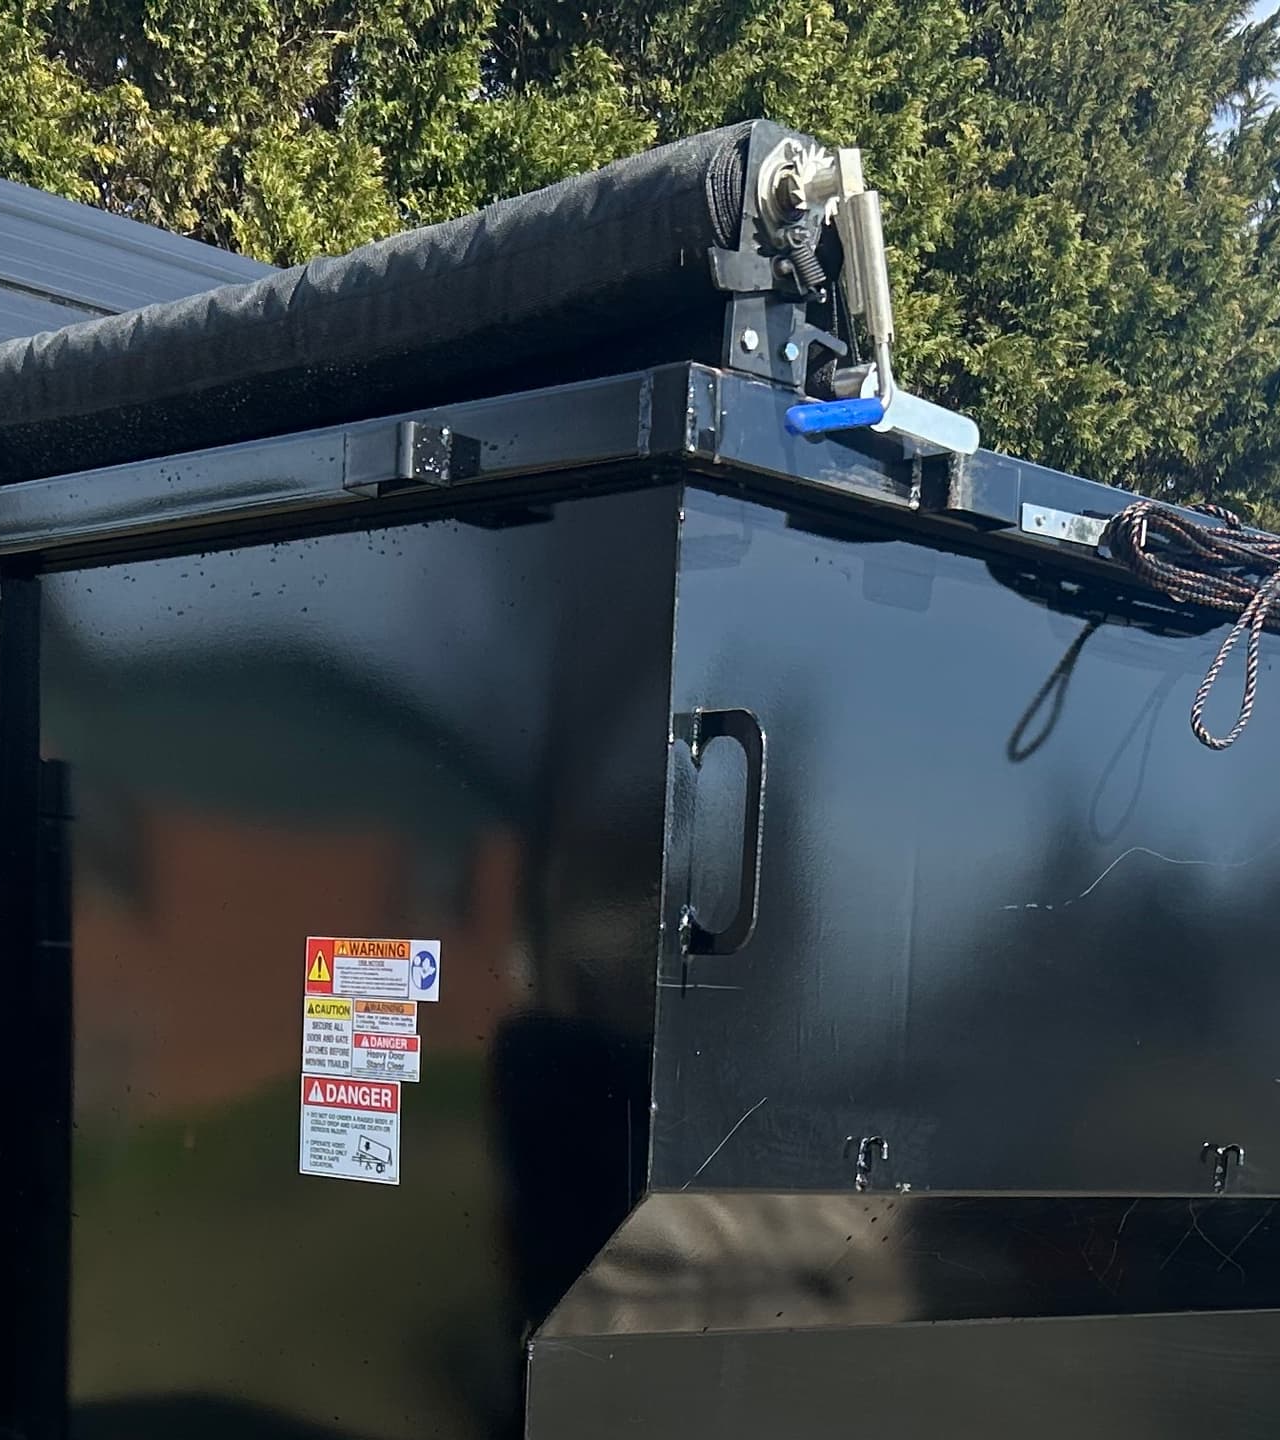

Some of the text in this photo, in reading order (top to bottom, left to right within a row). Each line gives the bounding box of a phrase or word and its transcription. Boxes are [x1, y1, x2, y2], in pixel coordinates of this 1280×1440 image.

[349, 941, 406, 957] WARNING
[315, 1004, 351, 1016] CAUTION
[369, 1002, 404, 1013] WARNING
[312, 1021, 344, 1032] SECURE ALL
[322, 1034, 334, 1043] AND
[335, 1035, 349, 1044] GATE
[370, 1037, 408, 1050] DANGER
[329, 1047, 350, 1057] BEFORE
[366, 1050, 405, 1061] Heavy Door
[326, 1083, 392, 1108] DANGER
